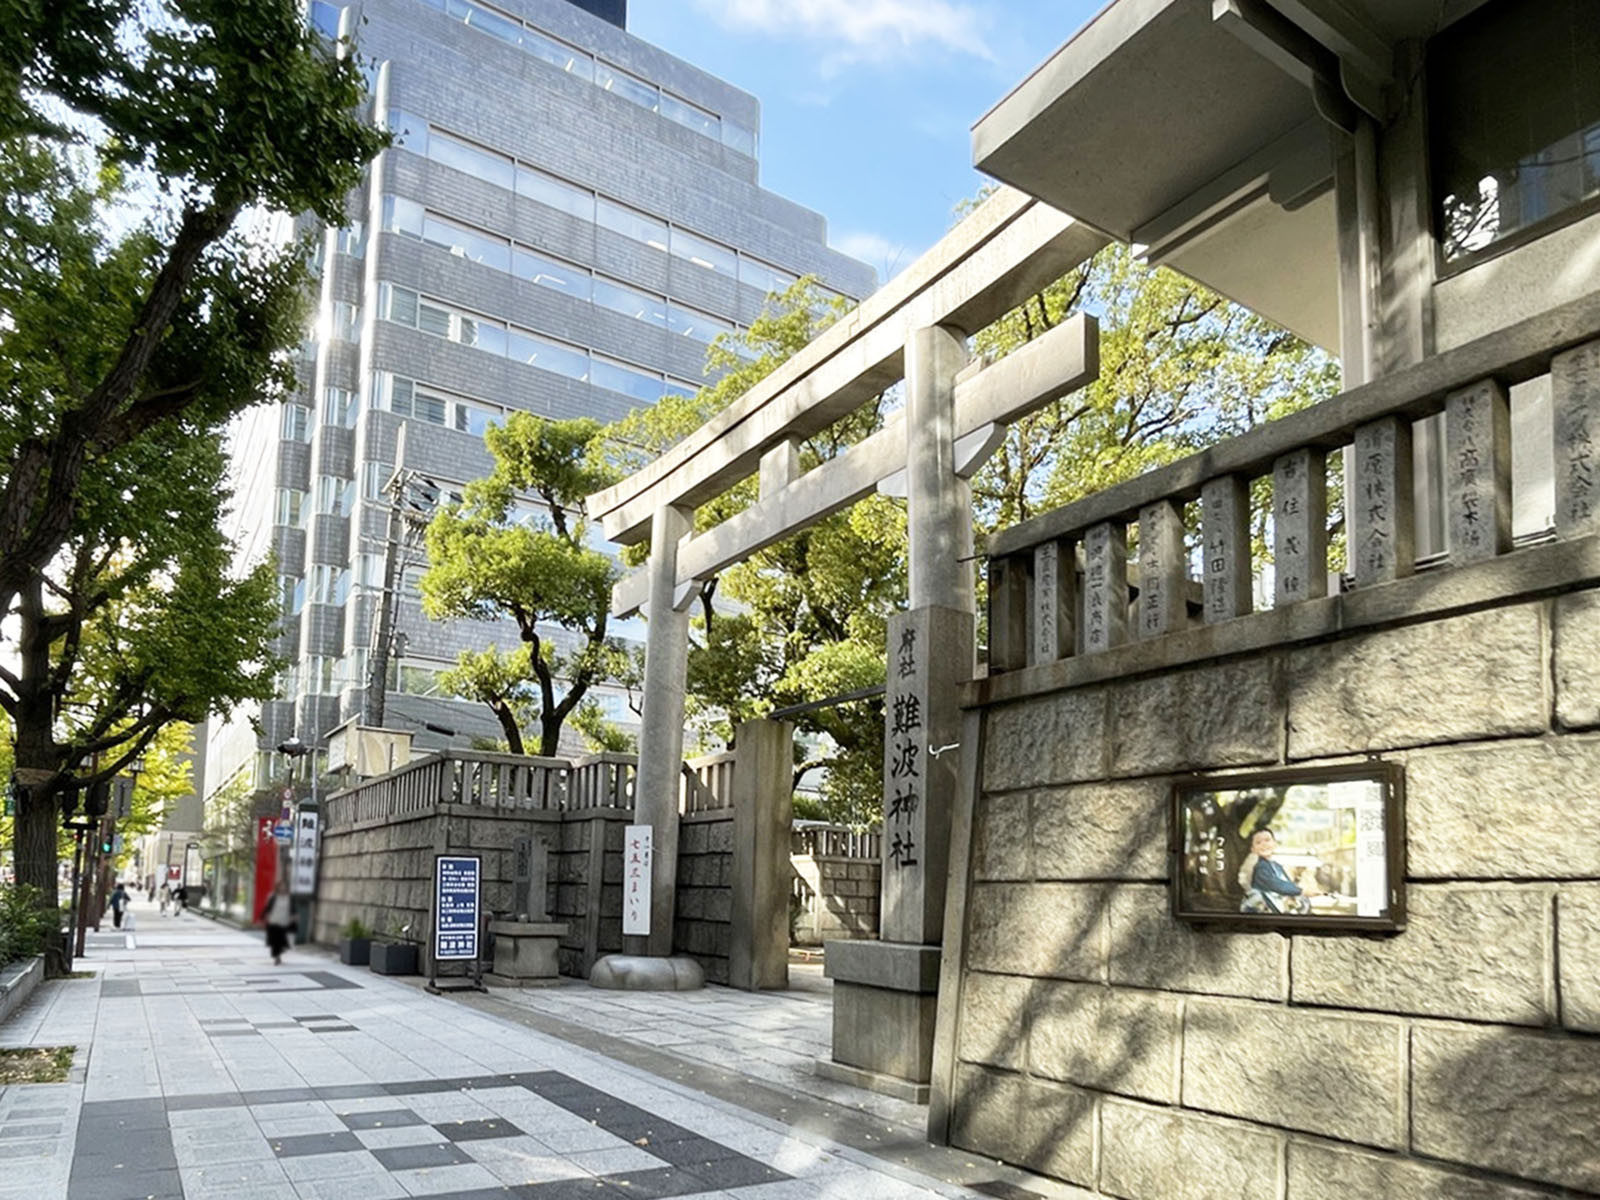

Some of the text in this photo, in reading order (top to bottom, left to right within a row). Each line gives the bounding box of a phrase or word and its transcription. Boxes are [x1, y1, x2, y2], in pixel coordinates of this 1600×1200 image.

[887, 628, 922, 870] 府社 難波神社
[629, 839, 642, 922] 七五三まいり
